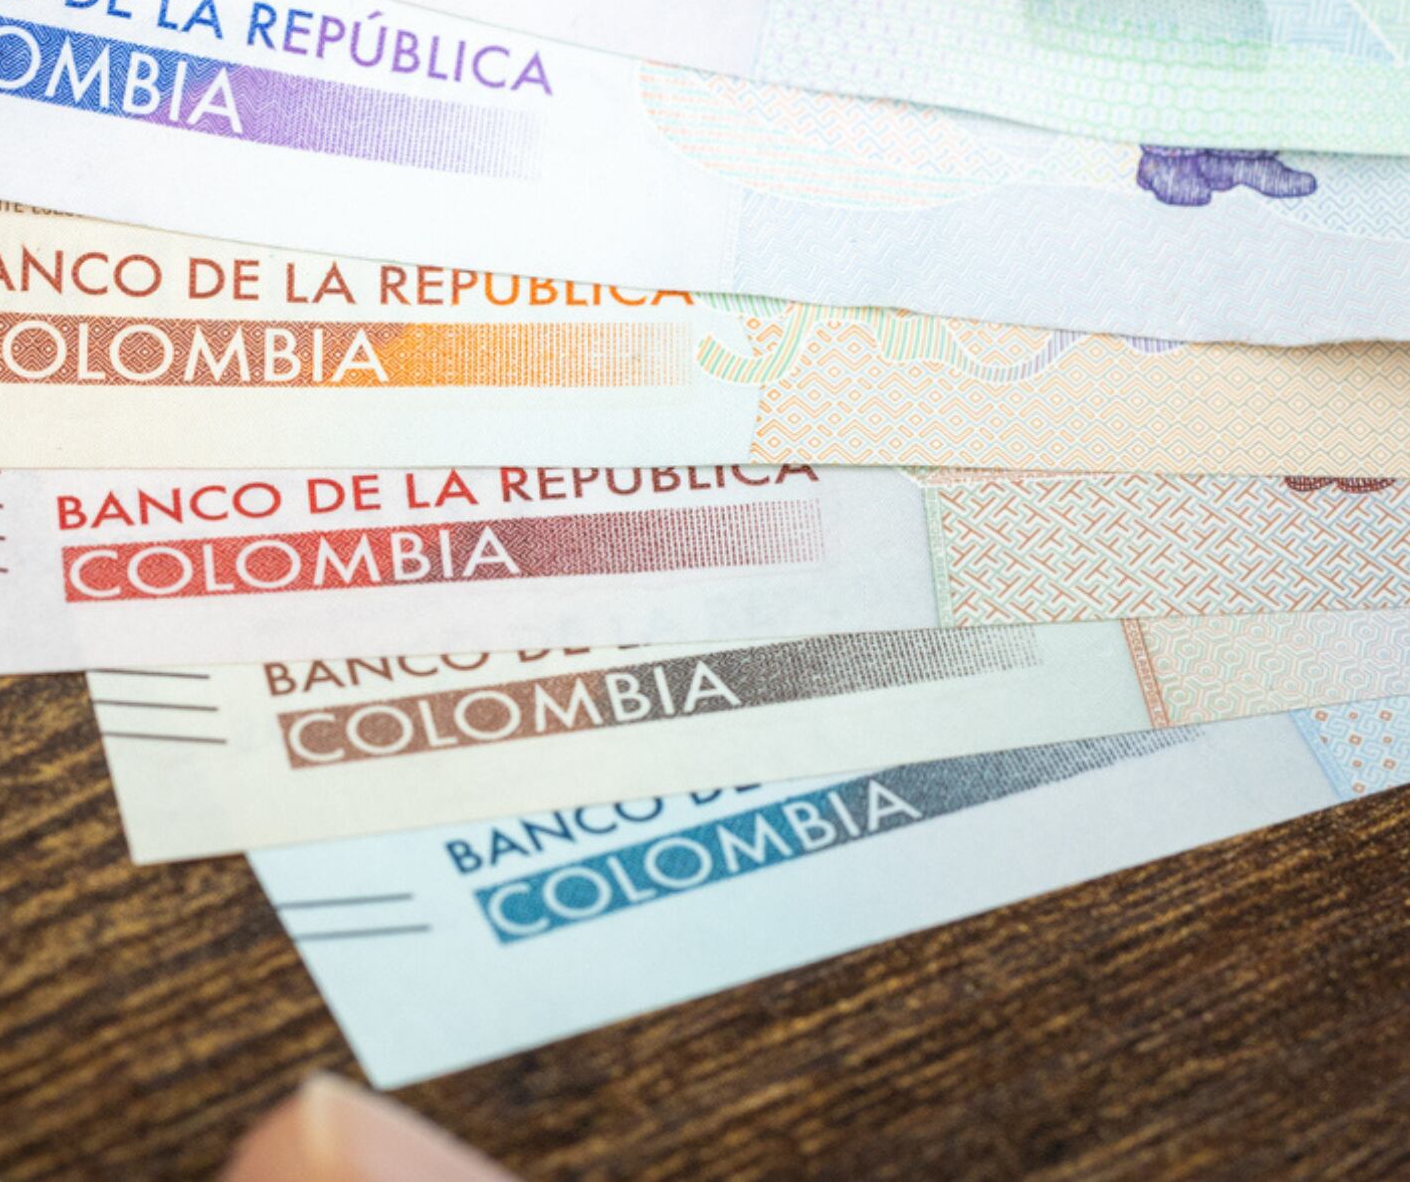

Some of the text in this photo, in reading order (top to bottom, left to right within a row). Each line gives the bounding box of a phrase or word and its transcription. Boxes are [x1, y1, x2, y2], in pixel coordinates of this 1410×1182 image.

[246, 9, 553, 96] REPÚBLICA
[188, 257, 261, 301] DE
[286, 261, 357, 305] LA
[57, 478, 282, 531] BANCO
[309, 474, 381, 514] DE
[405, 468, 480, 510] LA
[69, 523, 521, 600] COLOMBIA
[262, 652, 490, 697] BANCO
[290, 659, 742, 763] COLOMBIA
[445, 797, 664, 876] BANCO
[490, 779, 923, 937] COLOMBIA
